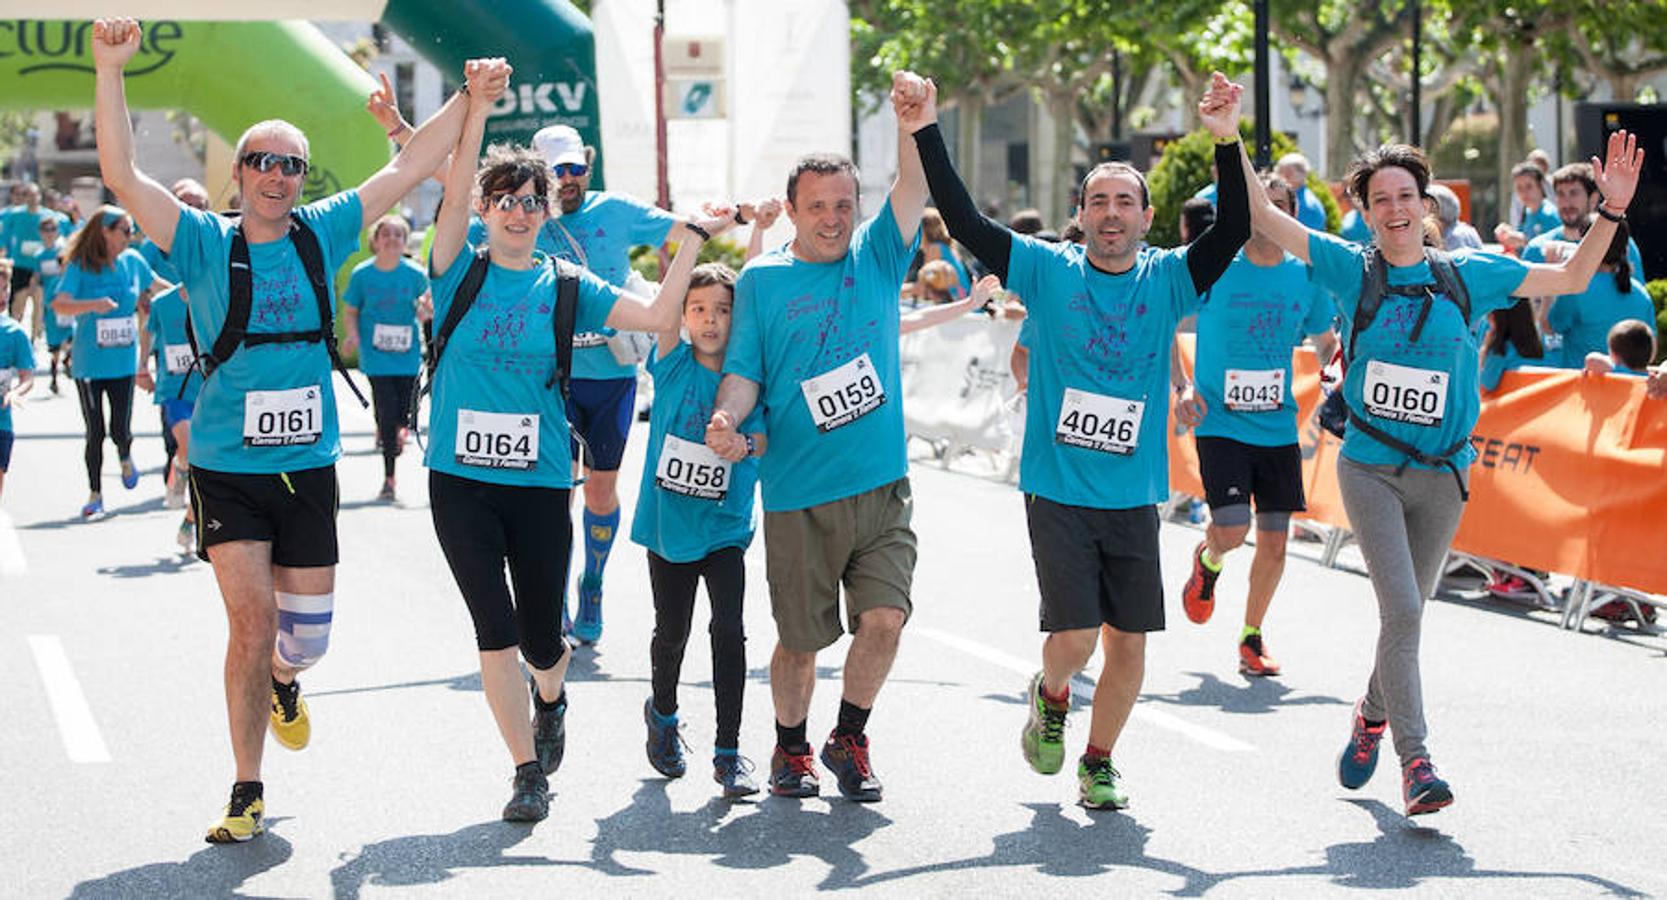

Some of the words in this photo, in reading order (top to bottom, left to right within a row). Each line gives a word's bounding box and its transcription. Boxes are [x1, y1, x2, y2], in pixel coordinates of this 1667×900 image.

[817, 374, 877, 418] 0159
[1227, 384, 1280, 403] 4043
[1371, 382, 1439, 414] 0160
[258, 407, 313, 435] 0161
[1062, 410, 1135, 443] 4046
[464, 430, 531, 457] 0164
[666, 457, 726, 489] 0158
